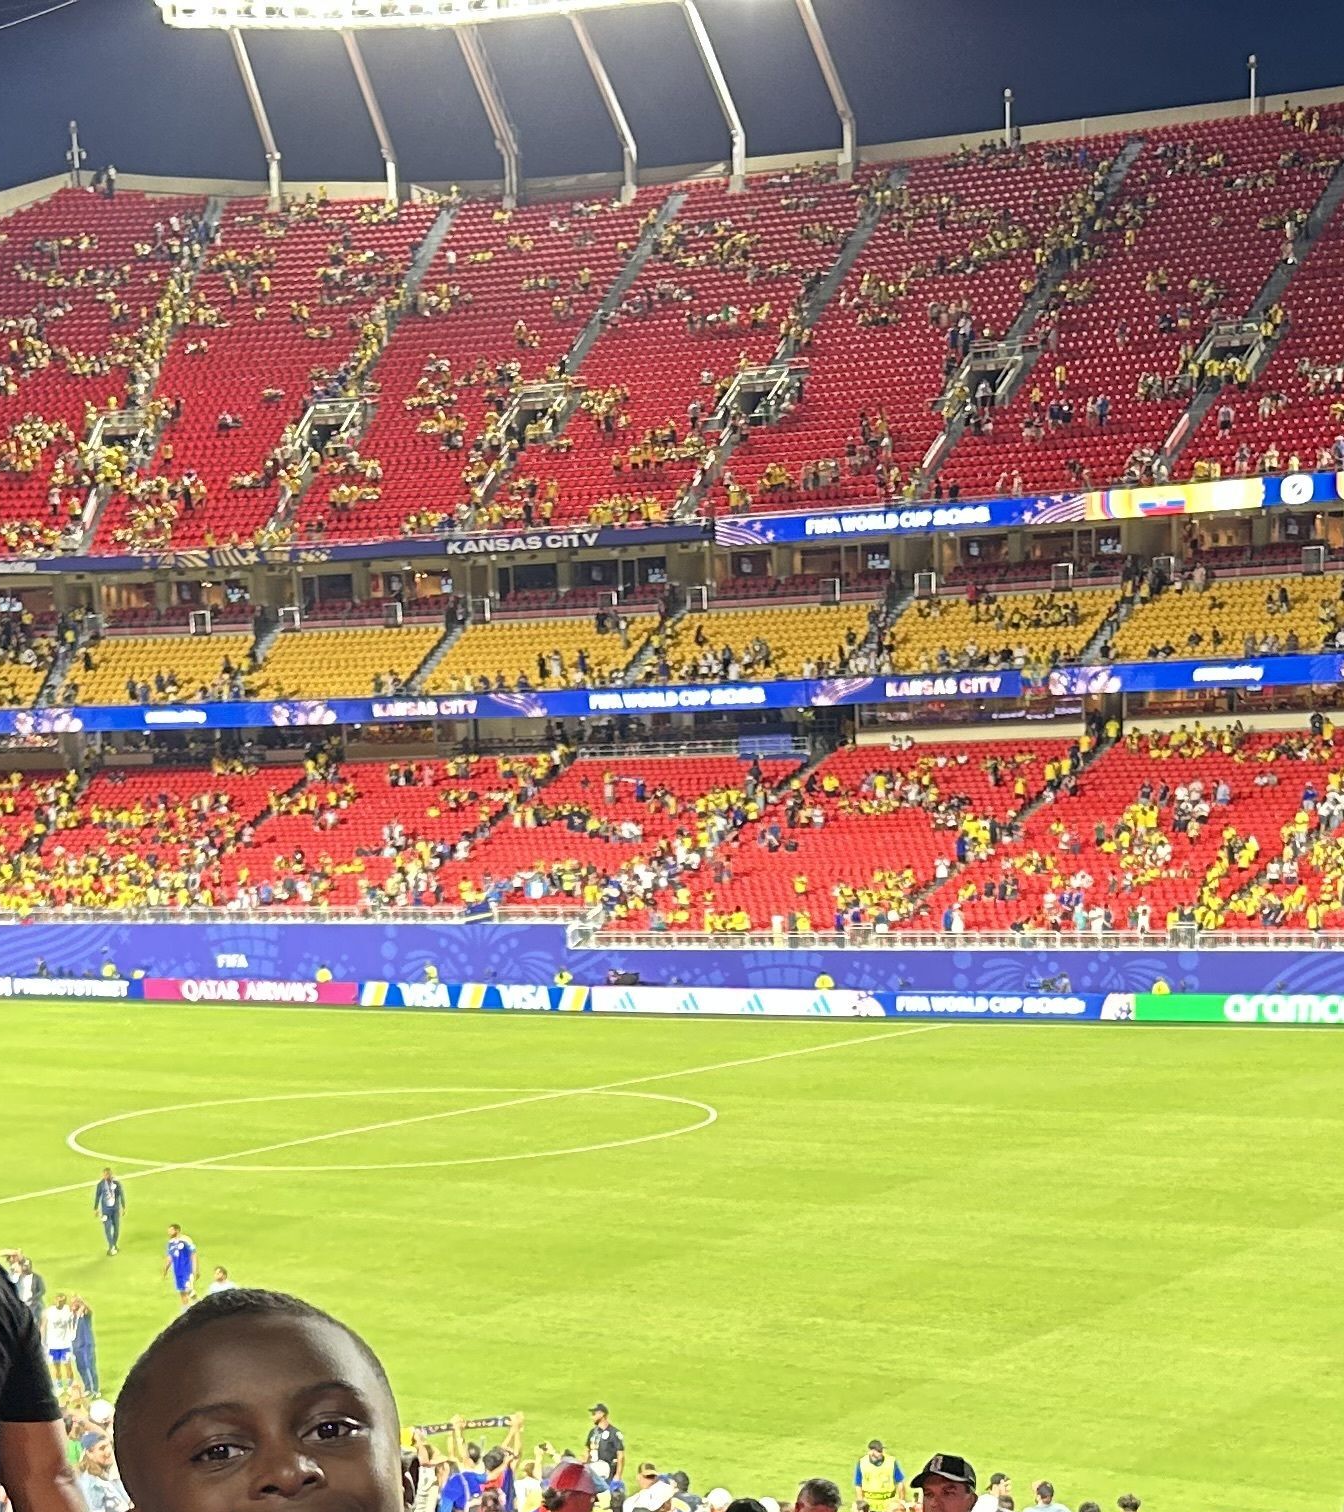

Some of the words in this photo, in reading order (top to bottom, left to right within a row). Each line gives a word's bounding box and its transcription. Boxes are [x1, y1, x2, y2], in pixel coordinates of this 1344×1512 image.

[446, 536, 544, 555] KANSAS
[545, 532, 599, 549] CITY
[885, 678, 958, 697] KANSAS
[959, 676, 1003, 694] CITY
[216, 953, 248, 969] FIFA
[180, 980, 240, 1002] QATAR
[245, 981, 319, 1003] AIRWAYS
[396, 982, 451, 1008] VISA
[496, 984, 551, 1010] VISA
[895, 995, 931, 1012] FIFA
[930, 996, 989, 1013] WORLD
[989, 996, 1023, 1014] CUP
